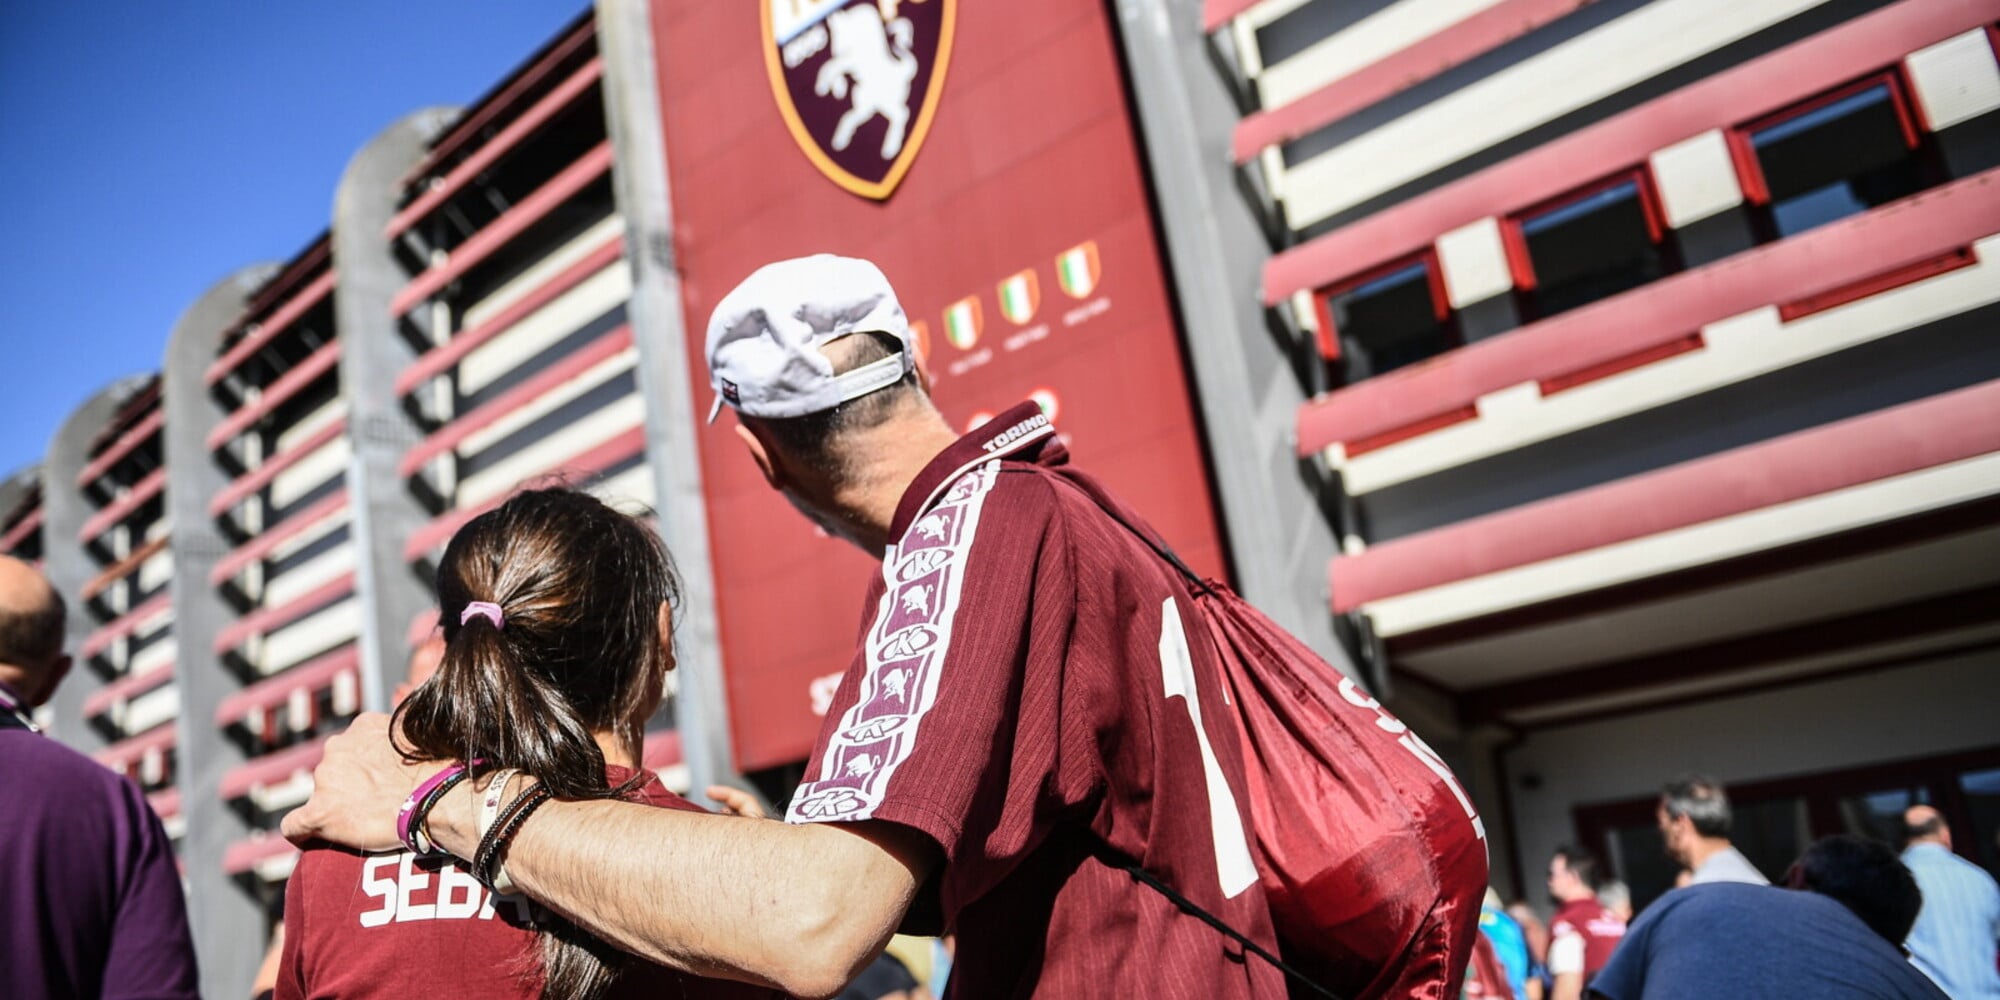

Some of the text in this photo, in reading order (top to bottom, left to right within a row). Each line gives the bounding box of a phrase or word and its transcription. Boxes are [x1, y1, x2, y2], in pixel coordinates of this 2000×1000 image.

[982, 413, 1048, 453] TORINO
[1158, 596, 1260, 899] 1
[360, 851, 551, 928] SEBA
